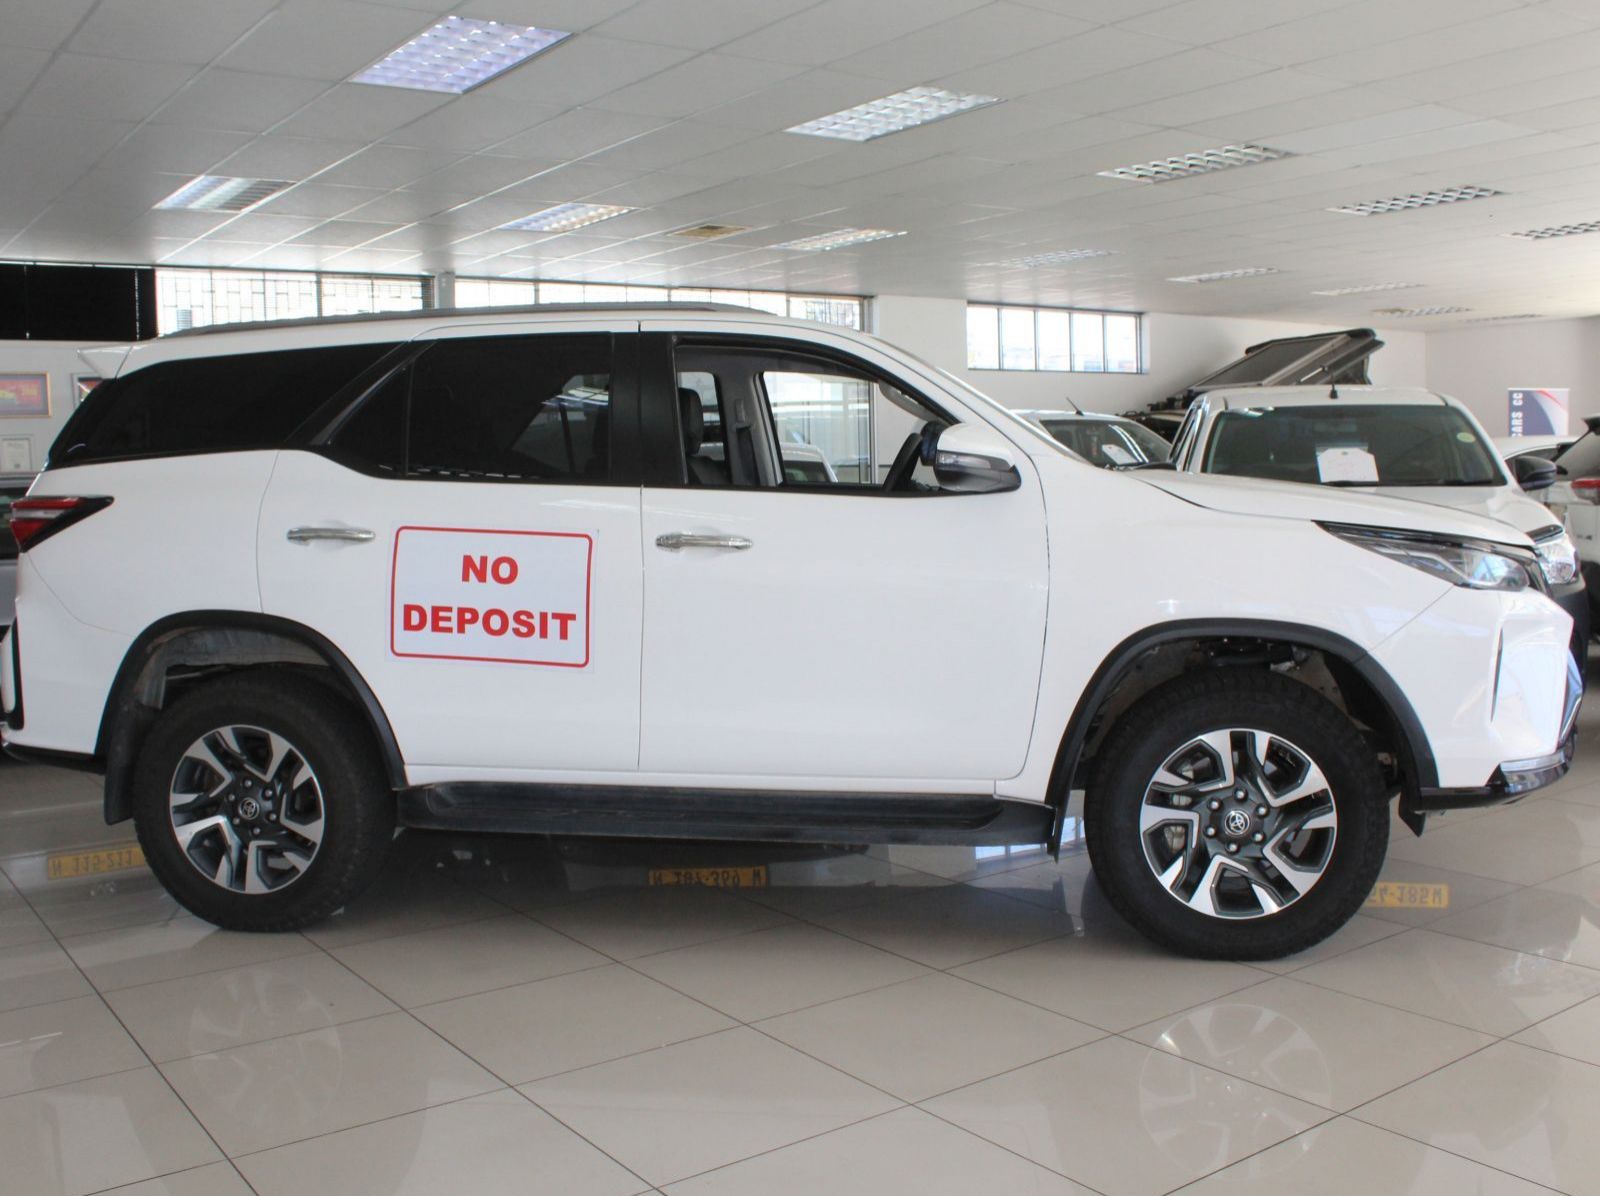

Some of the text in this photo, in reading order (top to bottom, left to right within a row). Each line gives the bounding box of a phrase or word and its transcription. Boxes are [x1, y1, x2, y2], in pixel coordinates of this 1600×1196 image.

[1512, 392, 1523, 406] CC
[461, 555, 519, 585] NO
[403, 604, 576, 641] DEPOSIT
